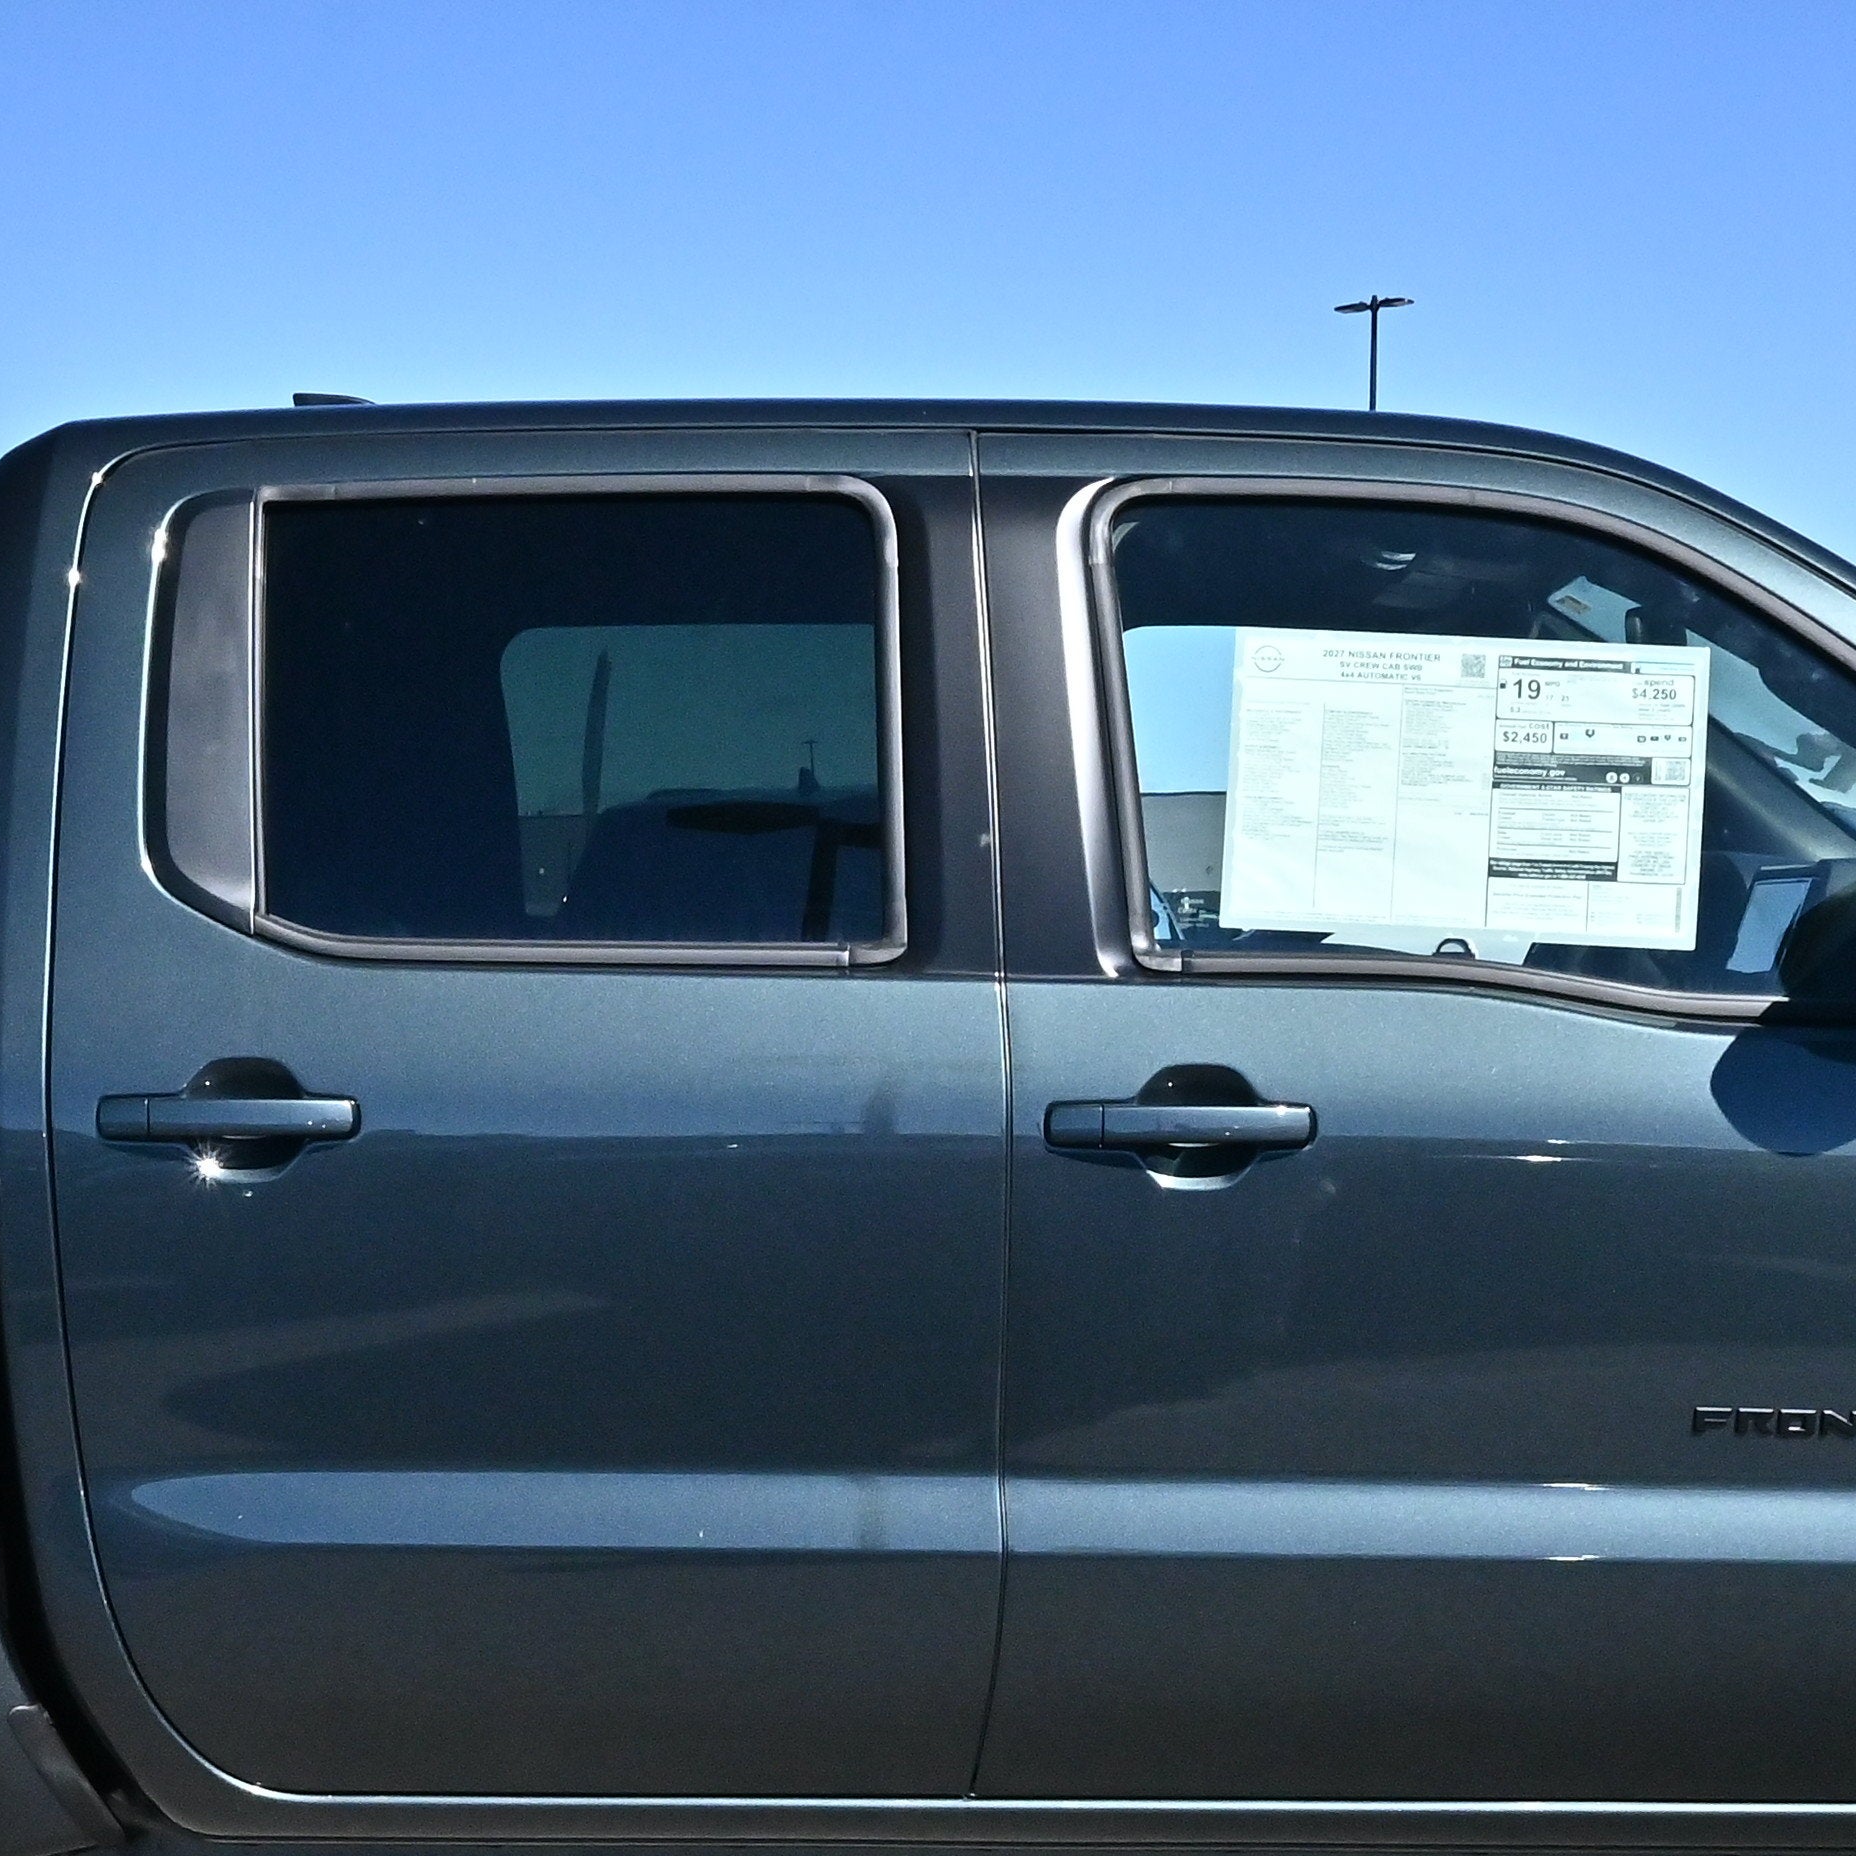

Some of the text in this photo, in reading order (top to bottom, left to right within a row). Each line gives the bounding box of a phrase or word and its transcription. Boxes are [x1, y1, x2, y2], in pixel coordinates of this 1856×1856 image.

[1323, 649, 1441, 662] 2027 NISSAN FRONTIER
[1339, 661, 1352, 669] SV
[1354, 662, 1381, 670] CREW
[1382, 663, 1401, 671] CAB
[1357, 672, 1408, 681] AUTOMATIC
[1513, 678, 1541, 700] 19
[1644, 679, 1675, 688] spend
[1502, 731, 1547, 744] $2,450
